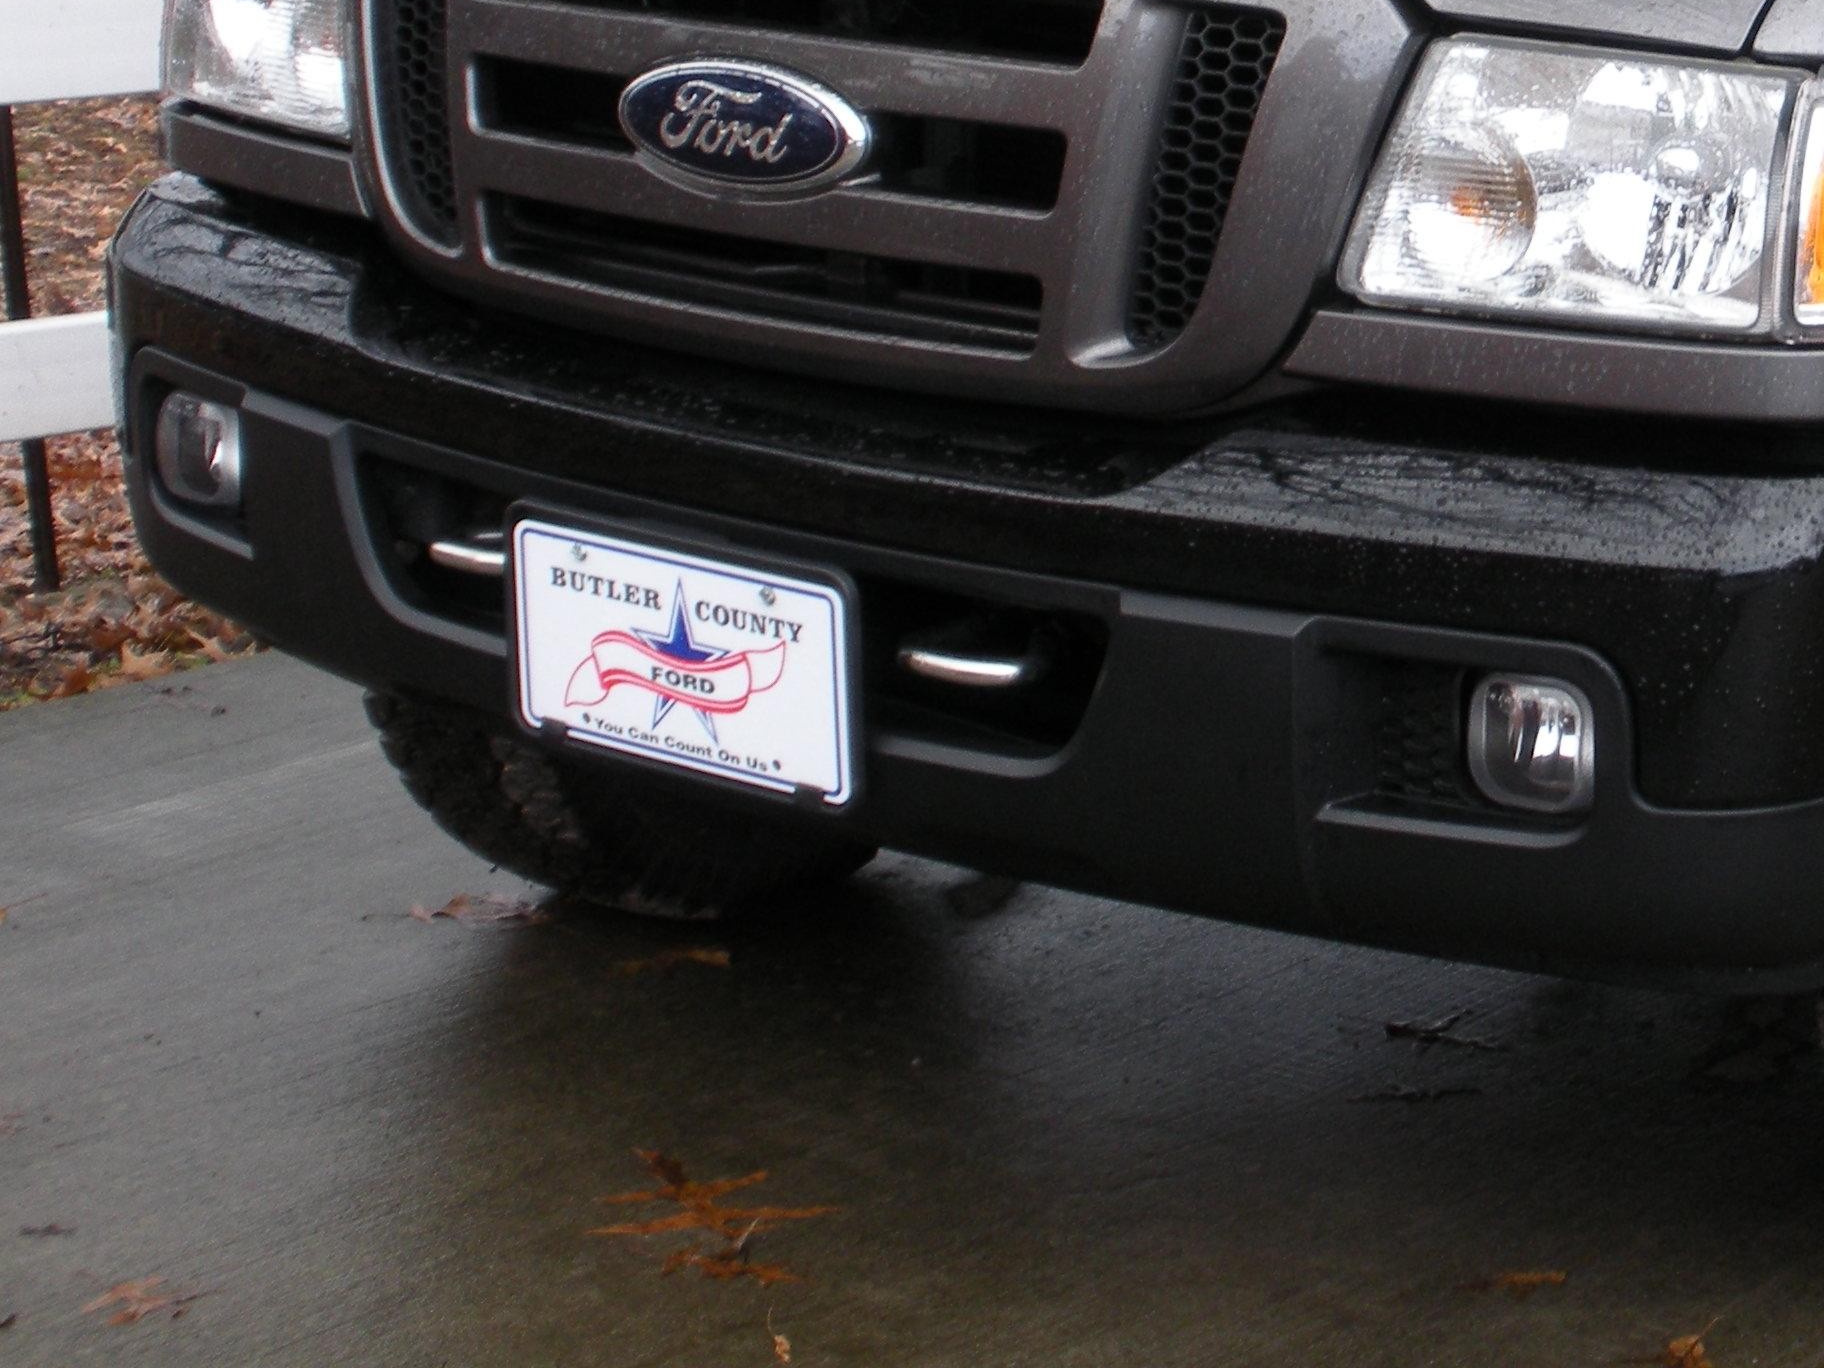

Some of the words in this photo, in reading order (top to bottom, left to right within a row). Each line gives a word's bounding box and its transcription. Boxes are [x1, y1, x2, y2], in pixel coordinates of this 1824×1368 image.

[661, 81, 793, 163] Ford
[551, 568, 662, 610] BUTLER
[694, 601, 803, 644] COUNTY
[651, 667, 715, 695] FORD
[595, 717, 624, 738] You
[629, 727, 660, 745] Can
[664, 735, 713, 761] Count
[718, 748, 741, 765] On
[746, 756, 769, 772] Us
